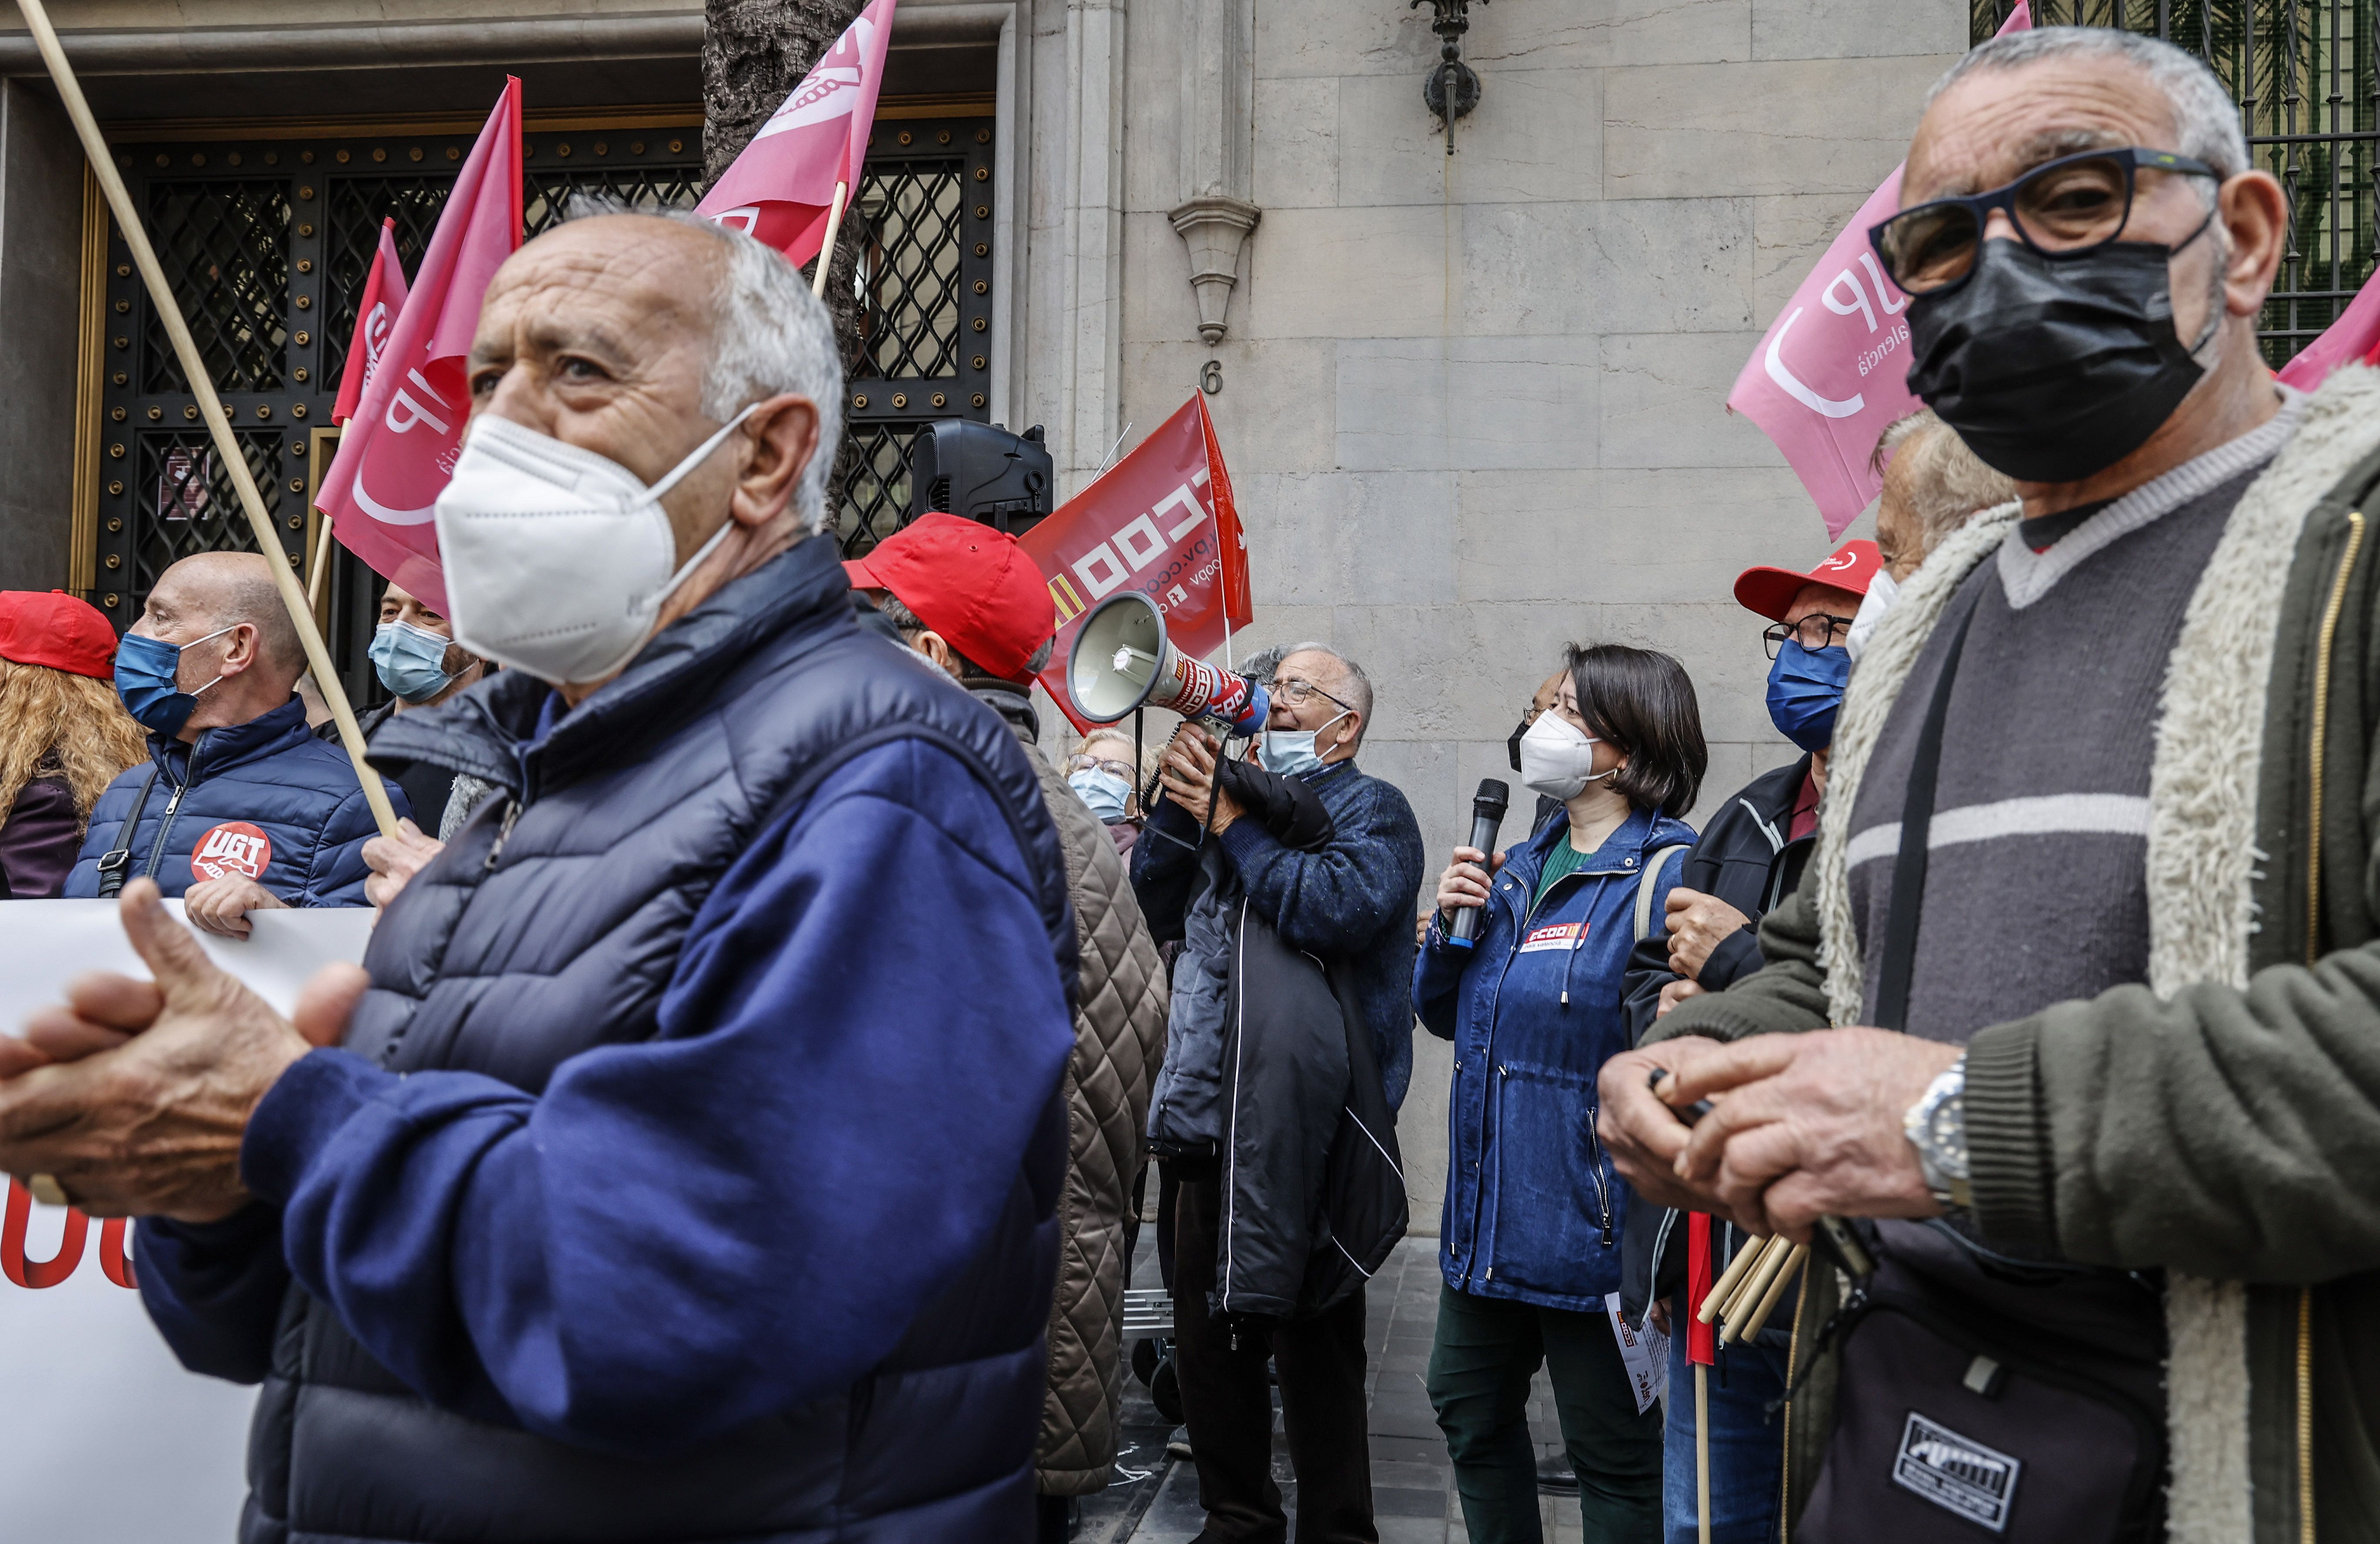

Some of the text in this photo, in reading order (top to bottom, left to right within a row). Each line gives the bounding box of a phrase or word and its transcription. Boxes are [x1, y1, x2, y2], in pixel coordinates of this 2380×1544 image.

[1200, 359, 1223, 395] 6
[202, 829, 265, 865] UGT
[1621, 1323, 1632, 1346] CCOO
